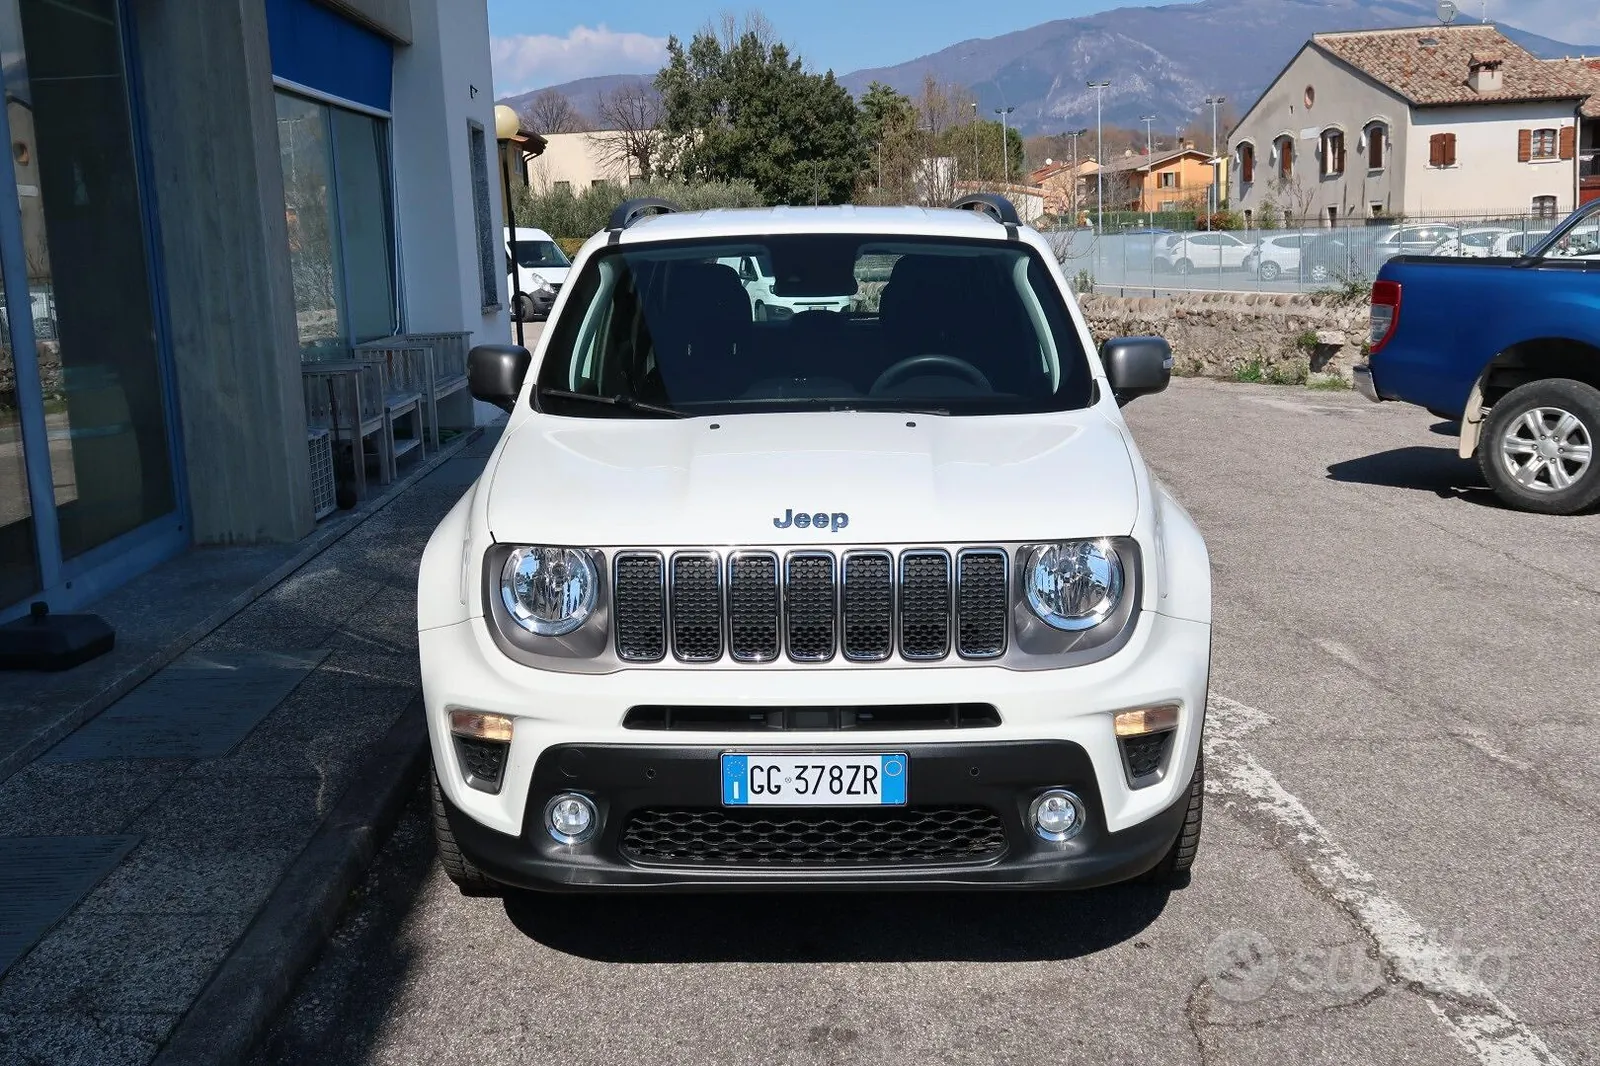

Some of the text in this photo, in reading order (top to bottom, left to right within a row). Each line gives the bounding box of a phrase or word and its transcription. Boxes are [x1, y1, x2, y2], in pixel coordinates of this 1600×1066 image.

[773, 509, 849, 532] Jeep
[750, 764, 878, 795] GG 378ZR
